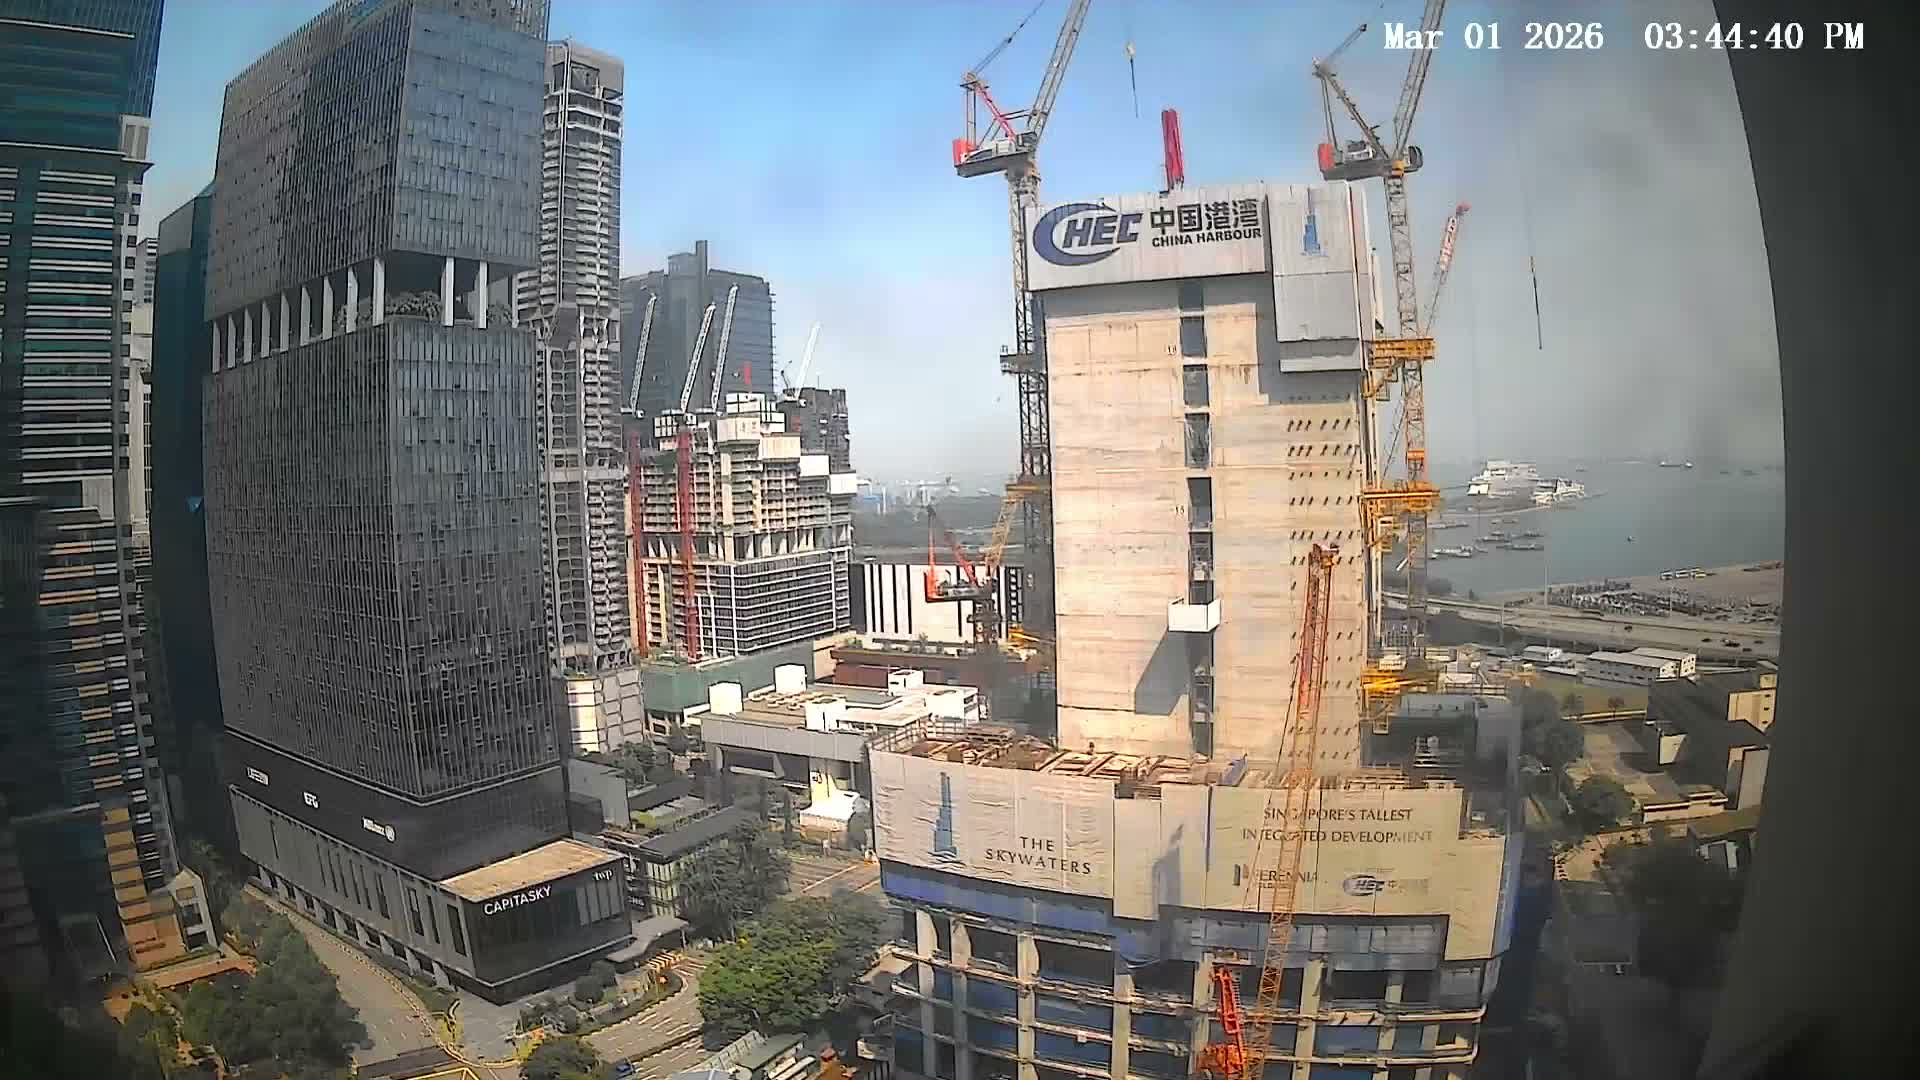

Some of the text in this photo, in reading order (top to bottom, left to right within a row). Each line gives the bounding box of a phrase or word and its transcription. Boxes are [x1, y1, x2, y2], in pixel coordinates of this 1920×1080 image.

[1151, 198, 1259, 235] 中国港湾
[1152, 228, 1262, 248] CHINA HARBOUR
[1360, 808, 1414, 822] TALLEST
[1019, 835, 1055, 852] THE
[1242, 828, 1432, 843] INTEGTED DEVELOPMENT
[985, 848, 1092, 875] SKYWATERS
[483, 885, 552, 916] CAPITASKY
